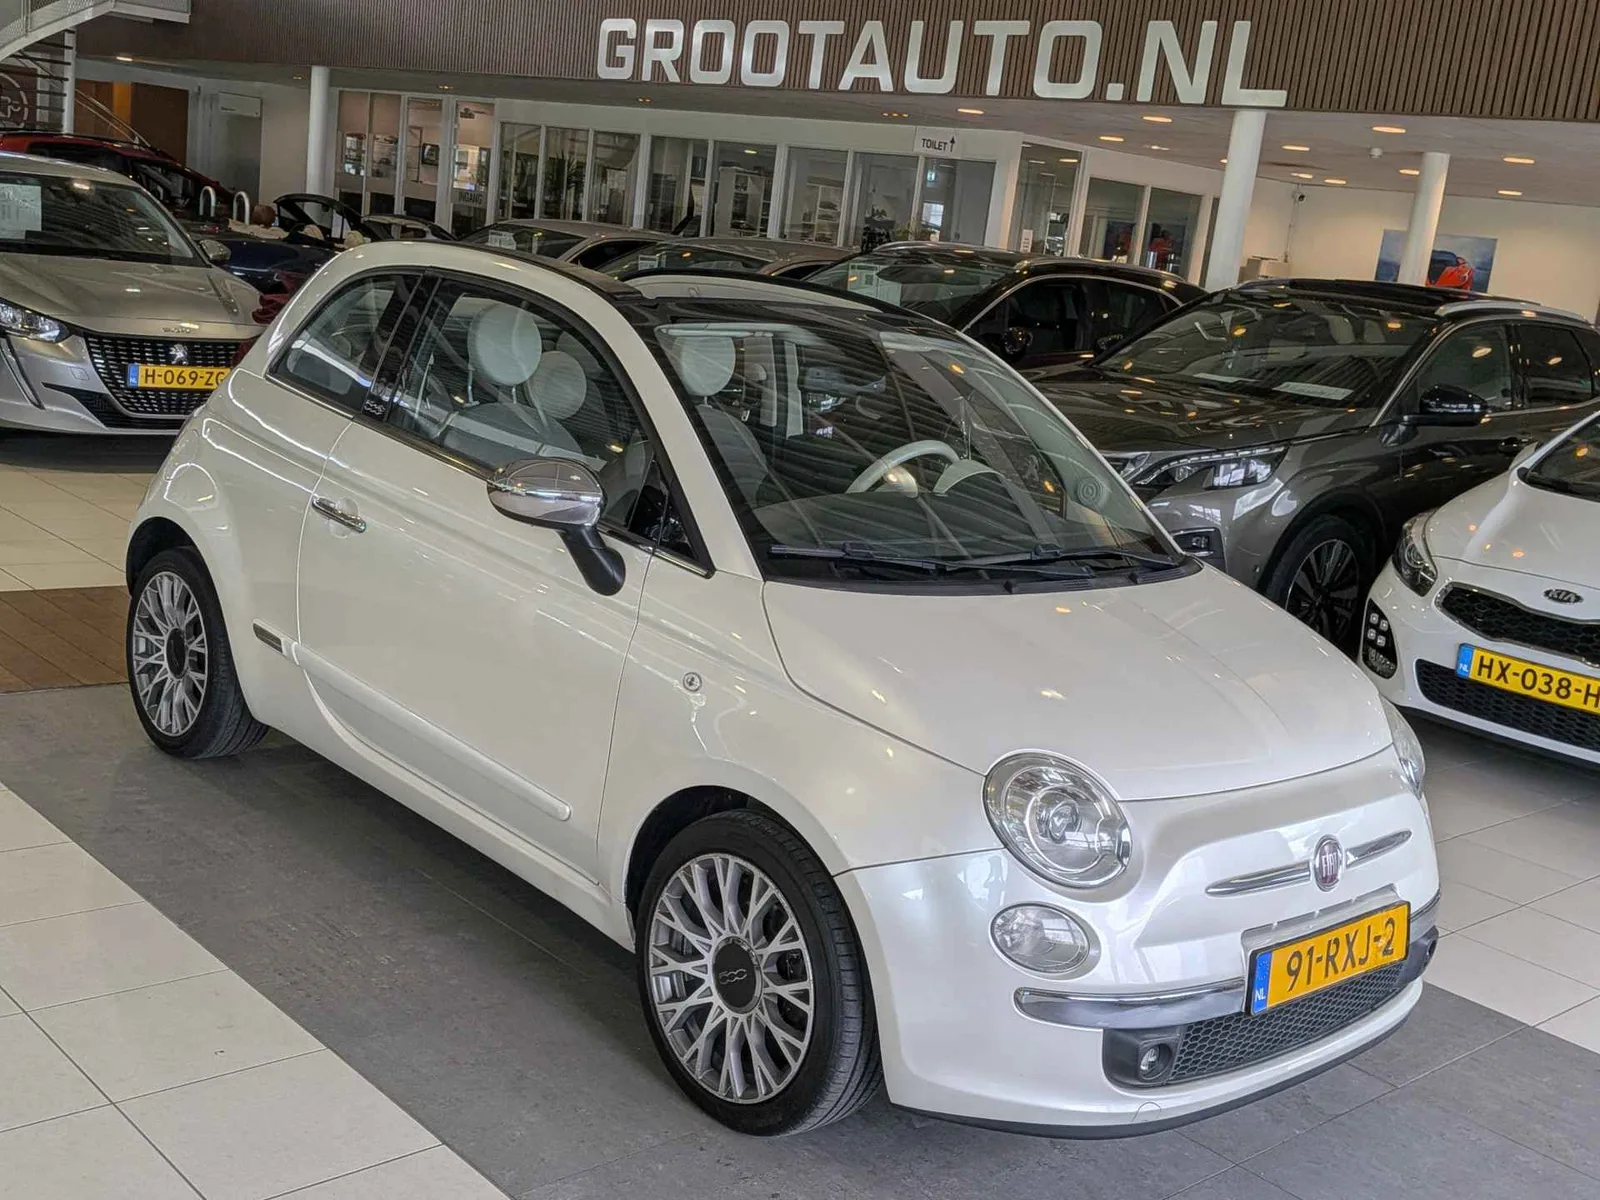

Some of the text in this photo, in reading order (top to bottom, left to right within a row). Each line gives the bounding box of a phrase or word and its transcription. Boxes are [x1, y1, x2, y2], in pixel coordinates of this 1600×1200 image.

[597, 18, 1288, 107] GROOTAUTO.NL
[921, 138, 948, 151] TOILET
[1548, 588, 1577, 603] KIA
[1459, 663, 1469, 672] NL
[1477, 655, 1600, 708] HX-038-H
[1321, 851, 1338, 878] FIAT
[1286, 917, 1396, 992] 91-RXJ-2
[719, 968, 747, 985] 500
[1254, 987, 1266, 1002] NL
